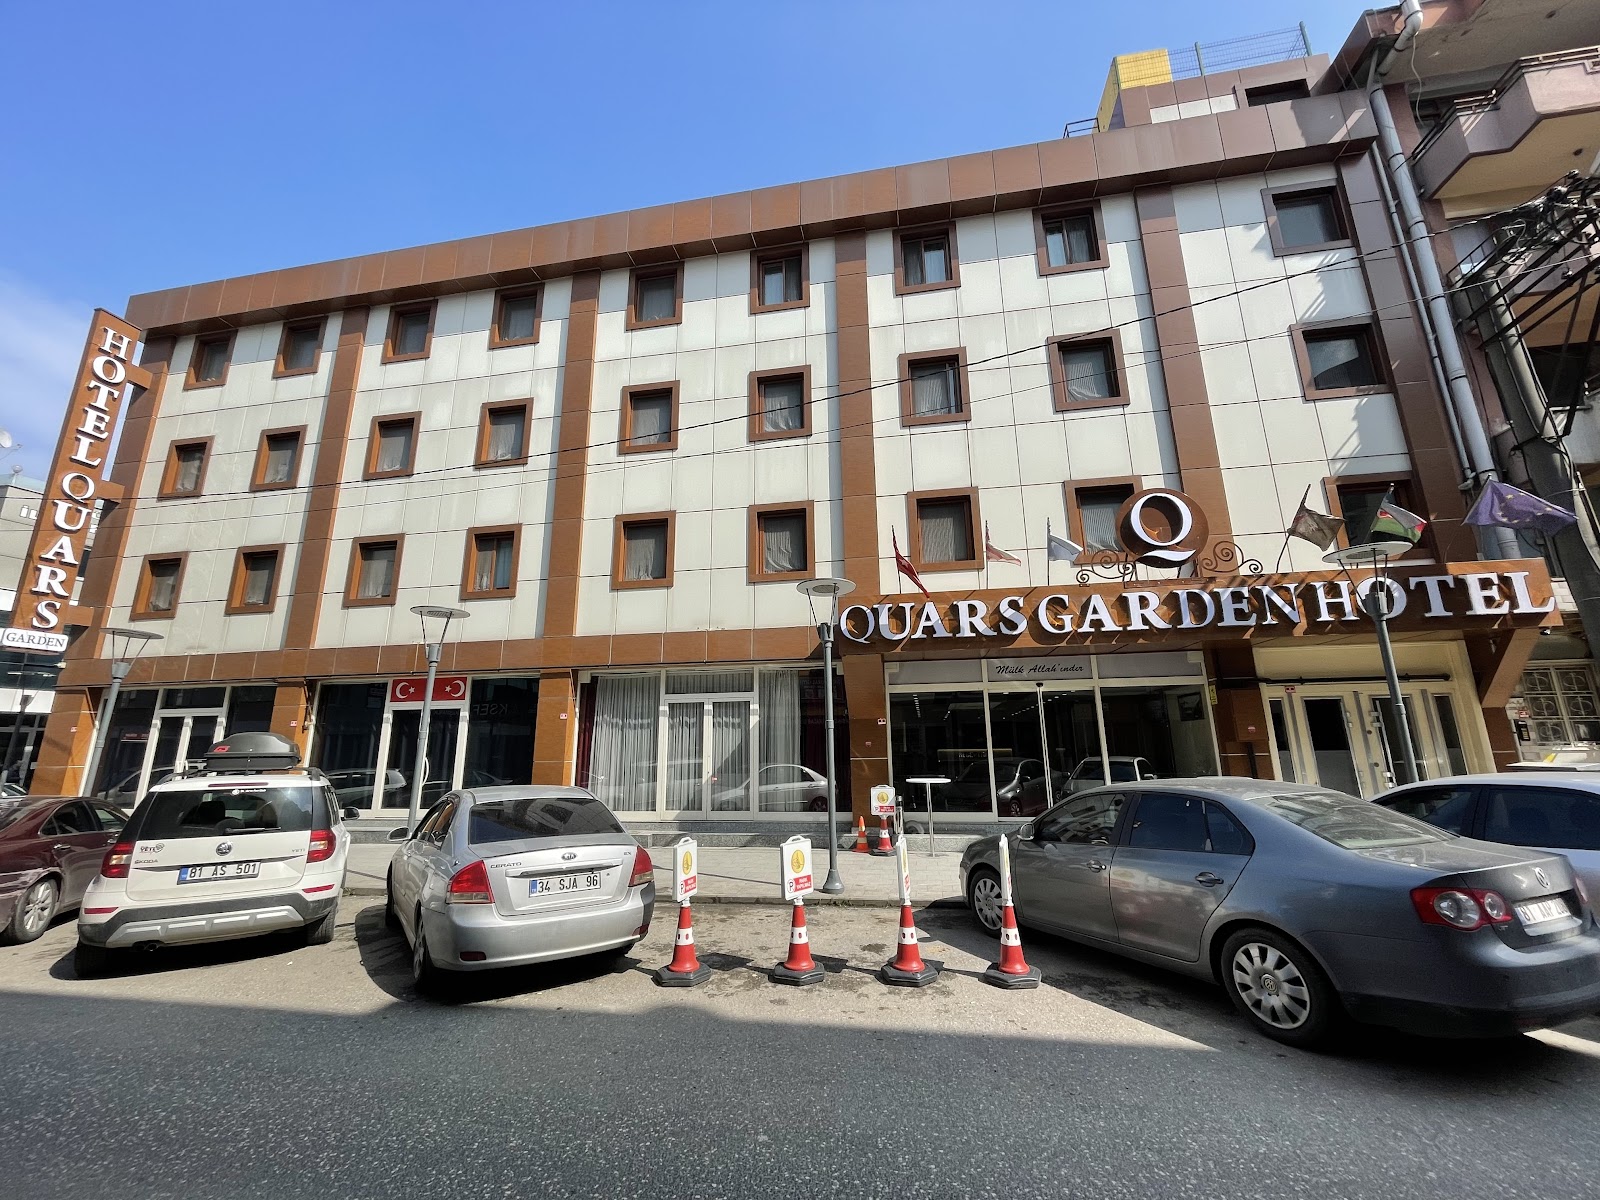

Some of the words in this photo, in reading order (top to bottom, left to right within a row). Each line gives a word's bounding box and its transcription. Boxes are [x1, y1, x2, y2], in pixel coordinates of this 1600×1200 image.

[71, 327, 131, 468] HOTEL
[1130, 492, 1196, 563] Q
[31, 472, 96, 630] QUARS
[840, 595, 1027, 645] QUARS
[1038, 584, 1303, 637] GARDEN
[1306, 571, 1556, 623] HOTEL
[5, 631, 66, 648] GARDEN
[995, 665, 1025, 675] Mülk
[189, 866, 203, 878] 81
[211, 864, 227, 877] AS
[235, 863, 257, 875] 501
[490, 861, 522, 869] CERATO
[537, 881, 551, 893] 34
[559, 877, 578, 891] SJA
[586, 875, 599, 888] 96
